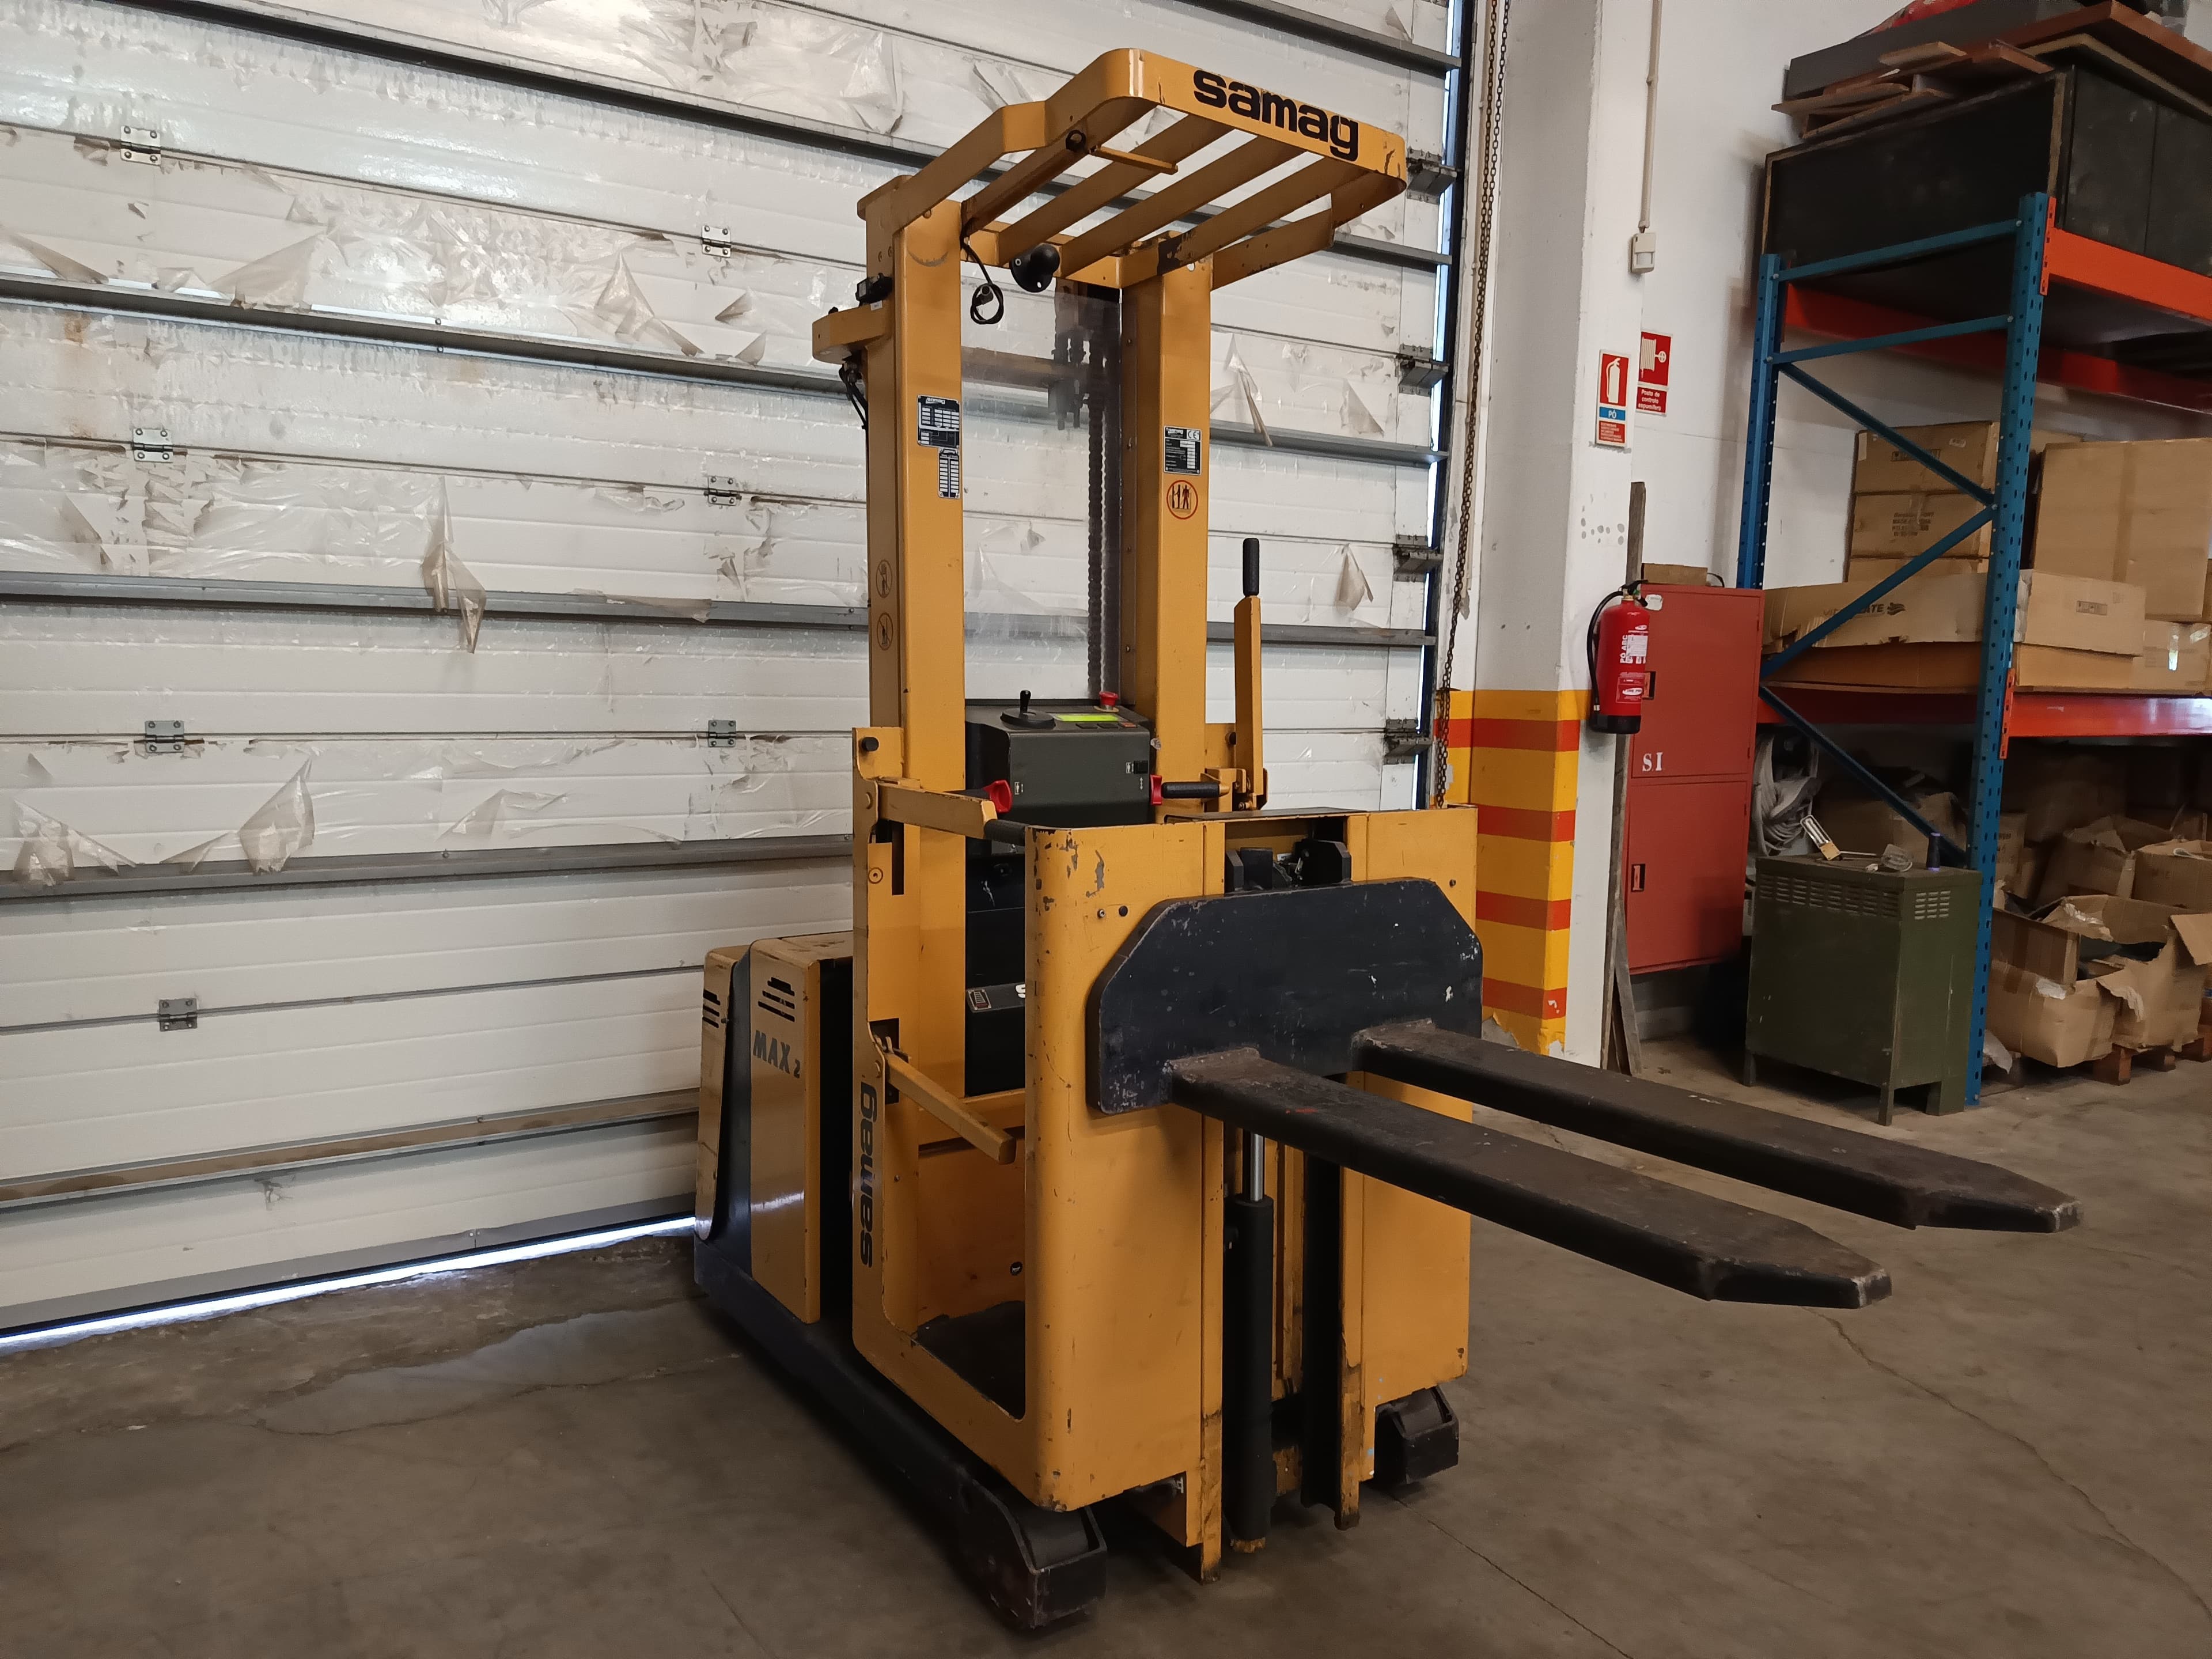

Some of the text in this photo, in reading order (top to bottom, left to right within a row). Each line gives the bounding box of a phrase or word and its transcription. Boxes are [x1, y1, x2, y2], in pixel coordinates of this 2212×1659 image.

[1194, 70, 1359, 161] samag
[1188, 431, 1197, 439] CE
[1608, 410, 1616, 419] PÓ
[753, 1029, 801, 1079] MAX 2
[861, 1081, 877, 1268] samag
